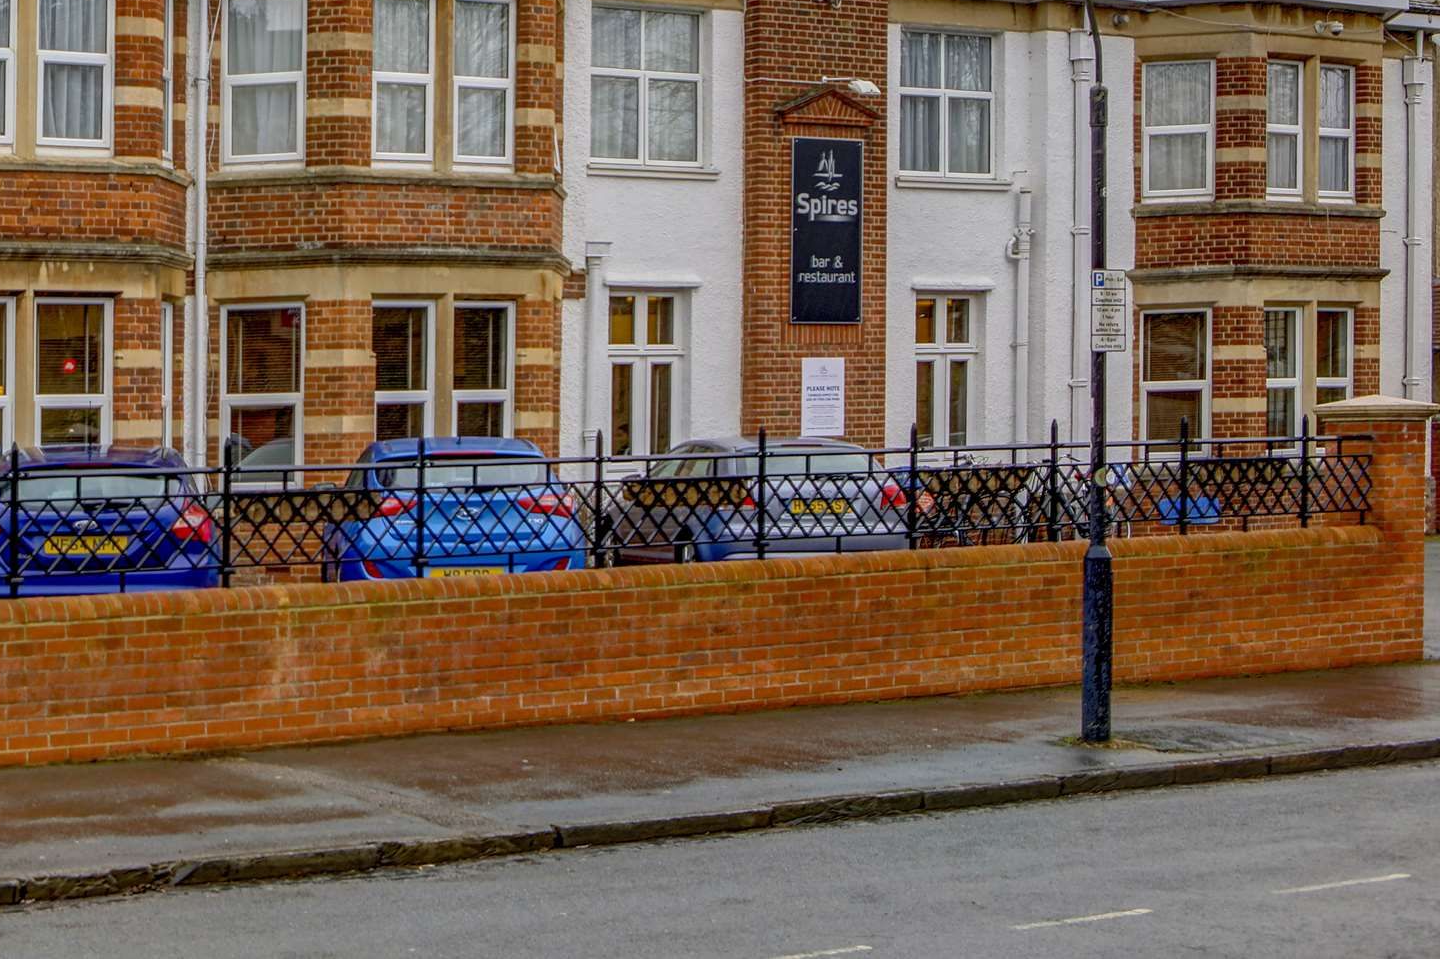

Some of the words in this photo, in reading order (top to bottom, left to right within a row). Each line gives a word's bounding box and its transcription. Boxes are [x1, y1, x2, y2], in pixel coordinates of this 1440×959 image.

[797, 192, 859, 221] Spires
[811, 254, 831, 268] bar
[834, 255, 844, 269] &
[798, 270, 857, 284] restaurant
